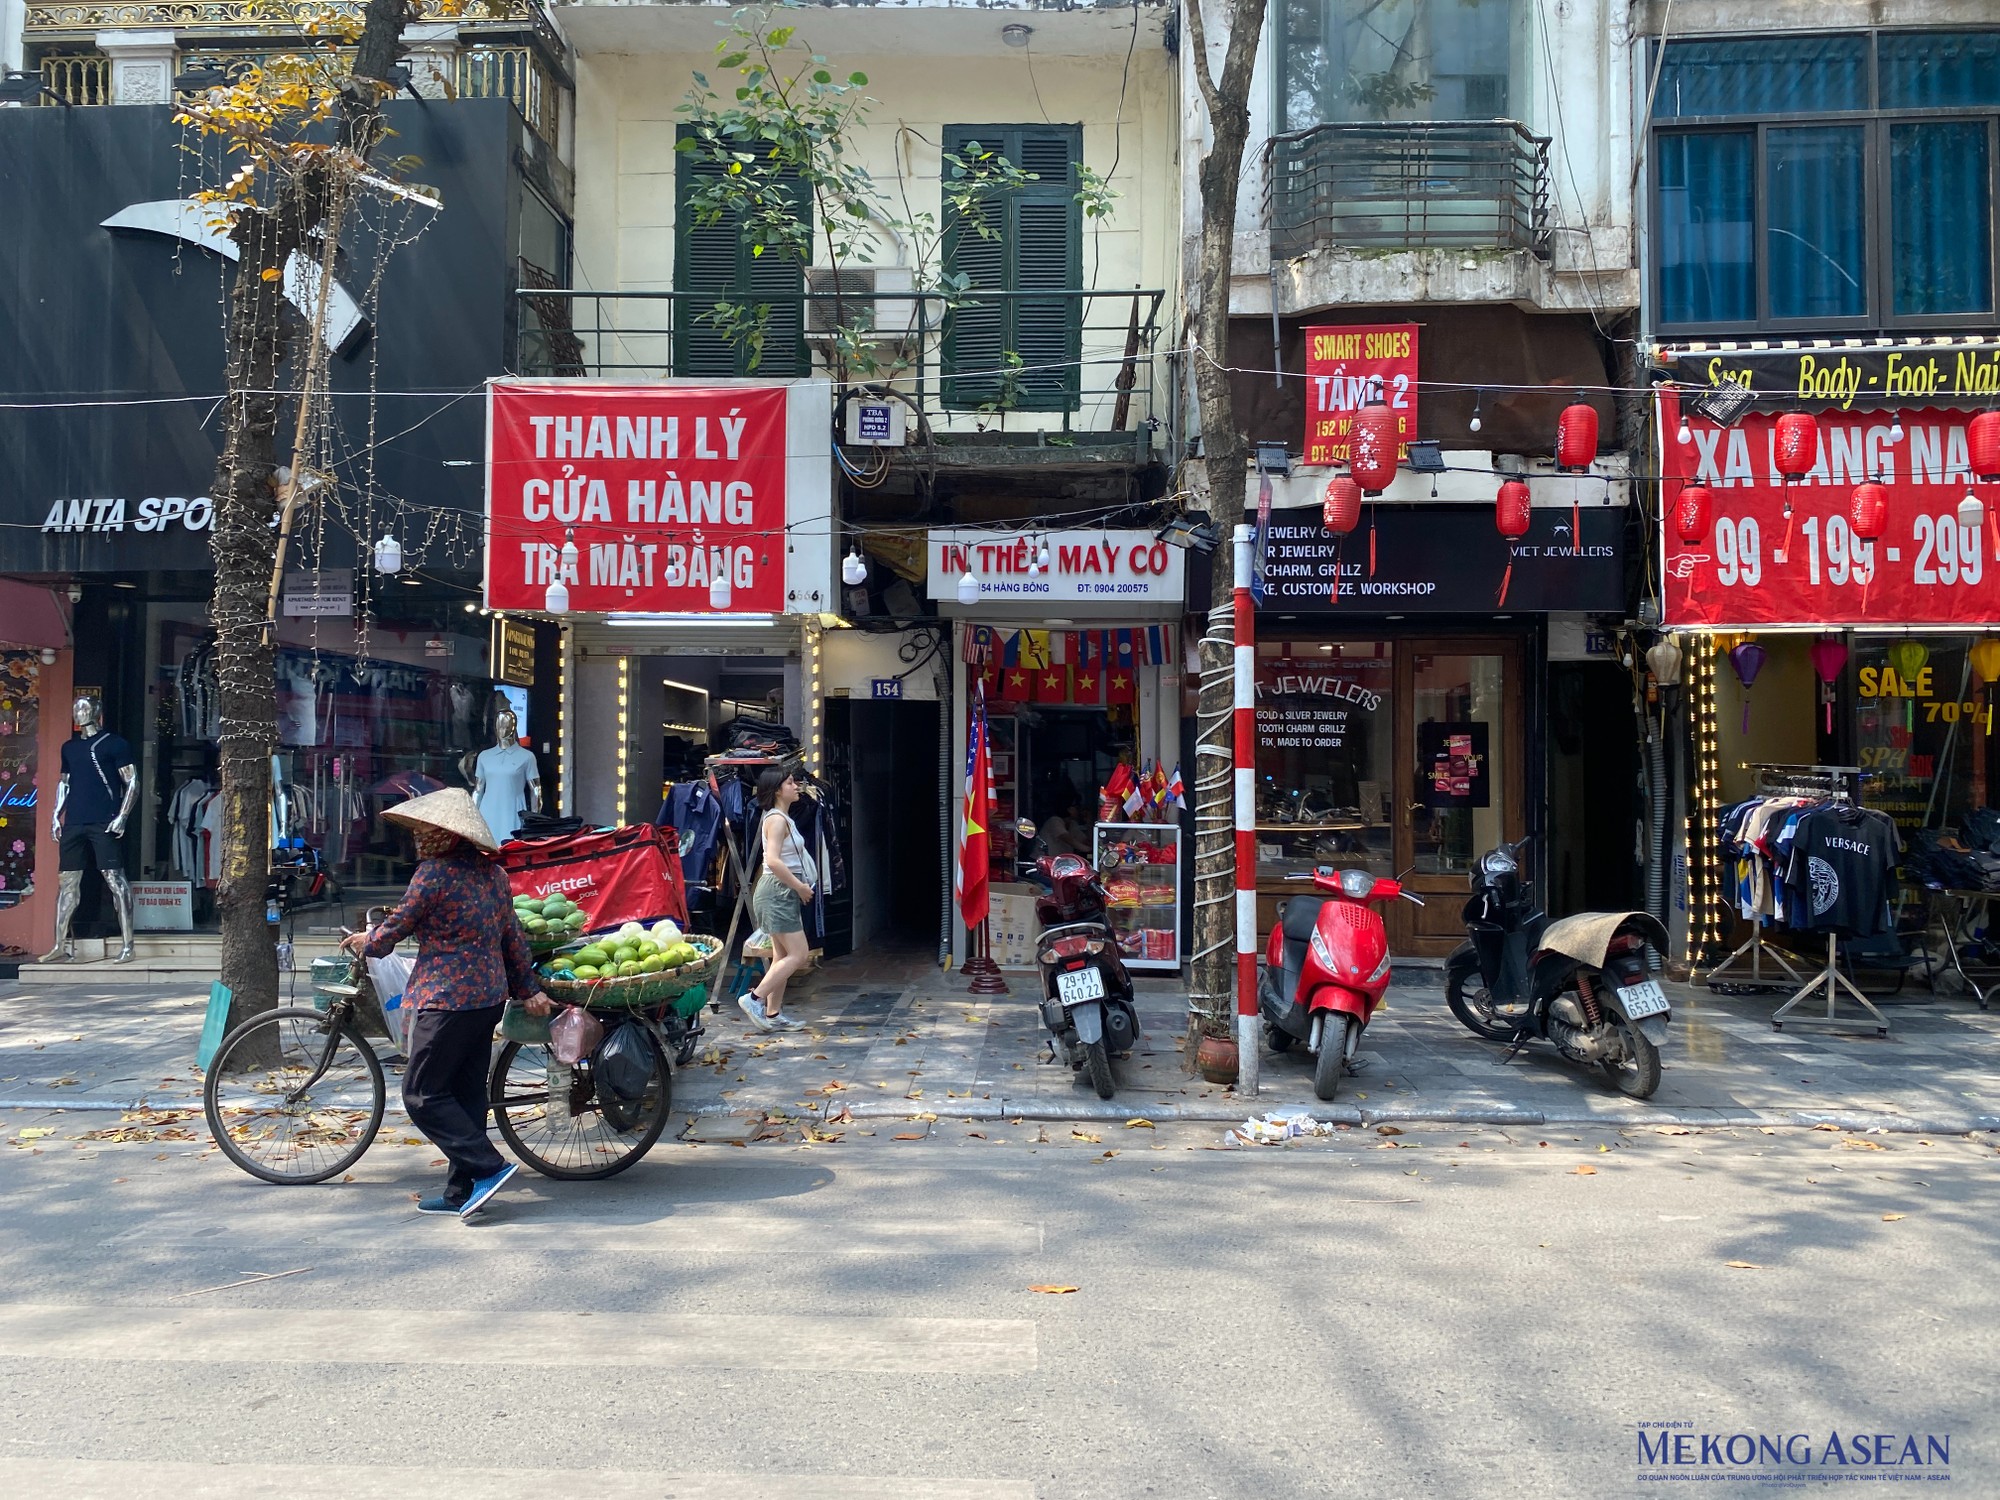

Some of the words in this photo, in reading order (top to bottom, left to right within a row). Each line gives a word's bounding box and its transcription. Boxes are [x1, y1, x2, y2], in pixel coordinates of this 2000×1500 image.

[1314, 334, 1361, 360] SMART
[1365, 332, 1410, 359] SHOES
[1315, 363, 1384, 411] TẦNG
[1392, 374, 1408, 408] 2
[1798, 354, 1861, 410] Body
[529, 416, 679, 459] THANH
[695, 408, 747, 461] LÝ
[1316, 420, 1336, 437] 152
[1910, 425, 2000, 485] NA
[523, 464, 612, 523] CỬA
[627, 471, 753, 525] HÀNG
[41, 498, 125, 533] ANTA
[1268, 526, 1318, 539] EWELRY
[942, 545, 968, 574] IN
[1059, 545, 1121, 575] MAY
[1280, 545, 1336, 558] JEWELRY
[1510, 546, 1540, 557] VIET
[1543, 546, 1614, 557] JEWELERS
[1715, 517, 1762, 587] 99
[1802, 515, 1875, 585] 199
[1914, 514, 1983, 585] 299
[590, 534, 658, 596] MẶT
[667, 528, 754, 588] BẰNG
[1265, 564, 1314, 577] CHARM,
[1318, 564, 1362, 577] GRLLZ
[994, 581, 1020, 593] HÀNG
[1023, 582, 1050, 593] BÔNG
[1077, 583, 1092, 593] ĐT:
[1094, 583, 1115, 593] 0904
[1117, 583, 1149, 593] 200575
[1282, 583, 1357, 597] CUSTOMZE,
[1360, 583, 1436, 596] WORKSHOP
[876, 683, 899, 696] 154
[1858, 666, 1934, 697] SALE
[1271, 675, 1382, 712] JEWELERS
[1256, 711, 1278, 720] GOLD
[1285, 711, 1311, 720] SILVER
[1313, 711, 1348, 720] JEWELRY
[1922, 702, 1989, 724] 70%
[1257, 724, 1284, 733] TOOTH
[1286, 724, 1315, 733] CHARM
[1318, 724, 1346, 733] GRILLZ
[1277, 738, 1300, 747] MADE
[1302, 738, 1312, 747] TO
[1314, 738, 1342, 747] ORDER
[1858, 747, 1907, 768] SPA
[1824, 836, 1870, 856] VERSACE
[535, 874, 595, 896] viettel
[579, 889, 599, 899] post
[1063, 971, 1093, 989] 29-P1
[1063, 984, 1101, 1003] 640.22
[1625, 983, 1657, 1002] 29-F1
[1628, 996, 1667, 1017] 653.16
